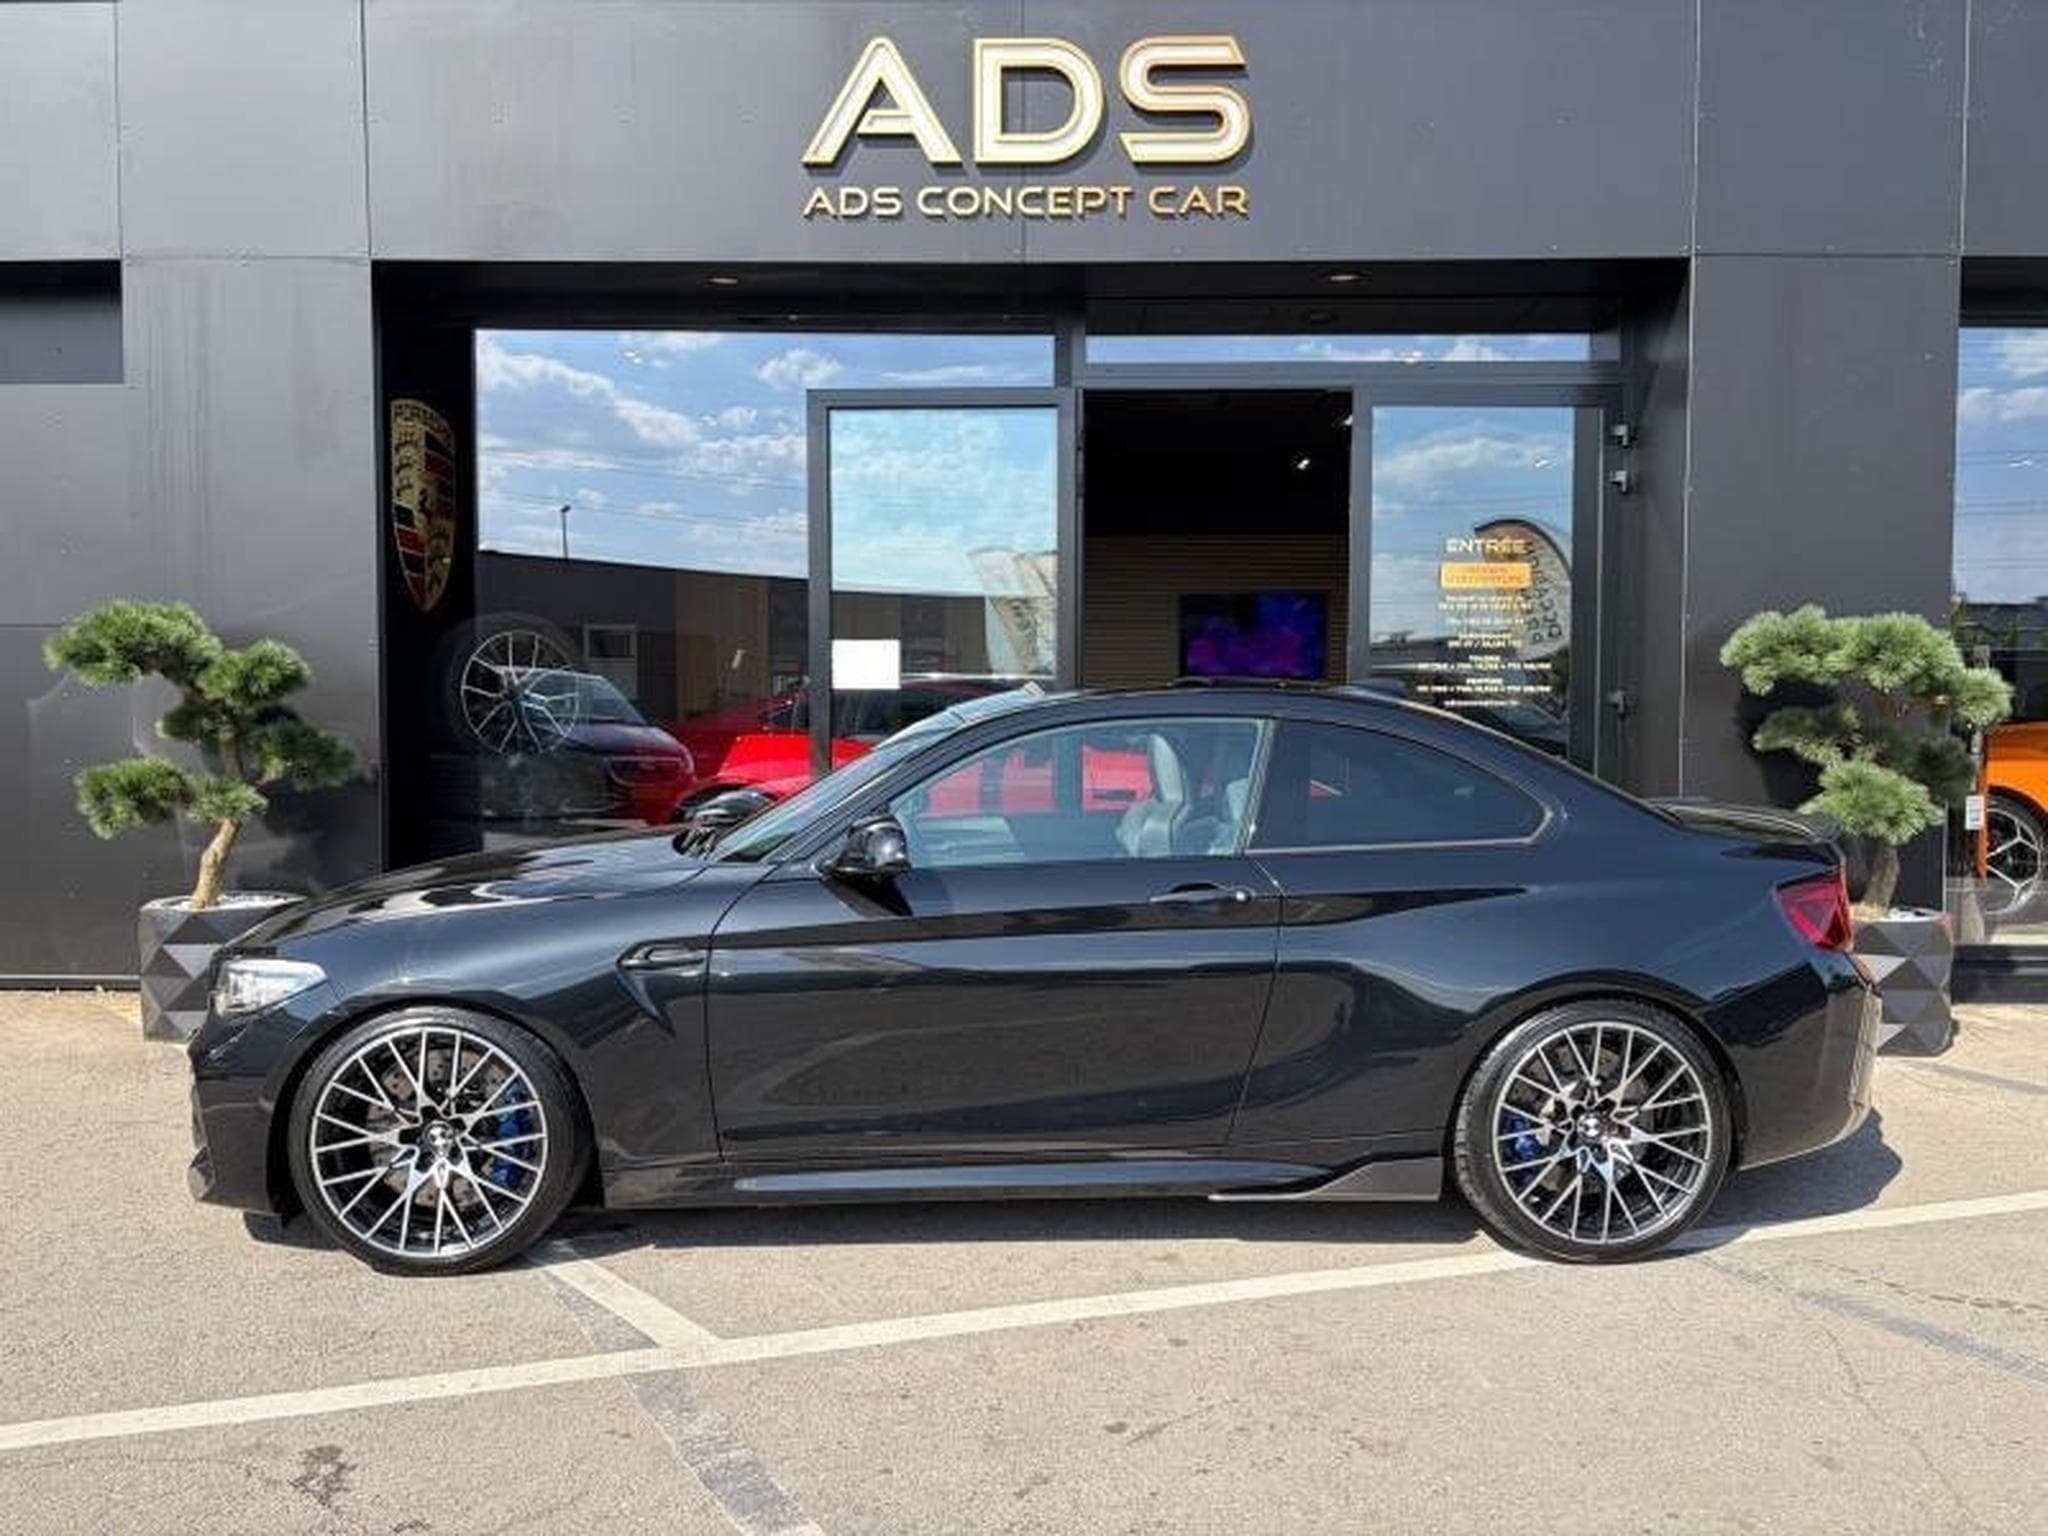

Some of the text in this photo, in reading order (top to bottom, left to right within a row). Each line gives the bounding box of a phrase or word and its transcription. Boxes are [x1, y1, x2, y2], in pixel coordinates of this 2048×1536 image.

[800, 35, 1251, 167] ADS
[804, 187, 1249, 218] ADS CONCEPT CAR
